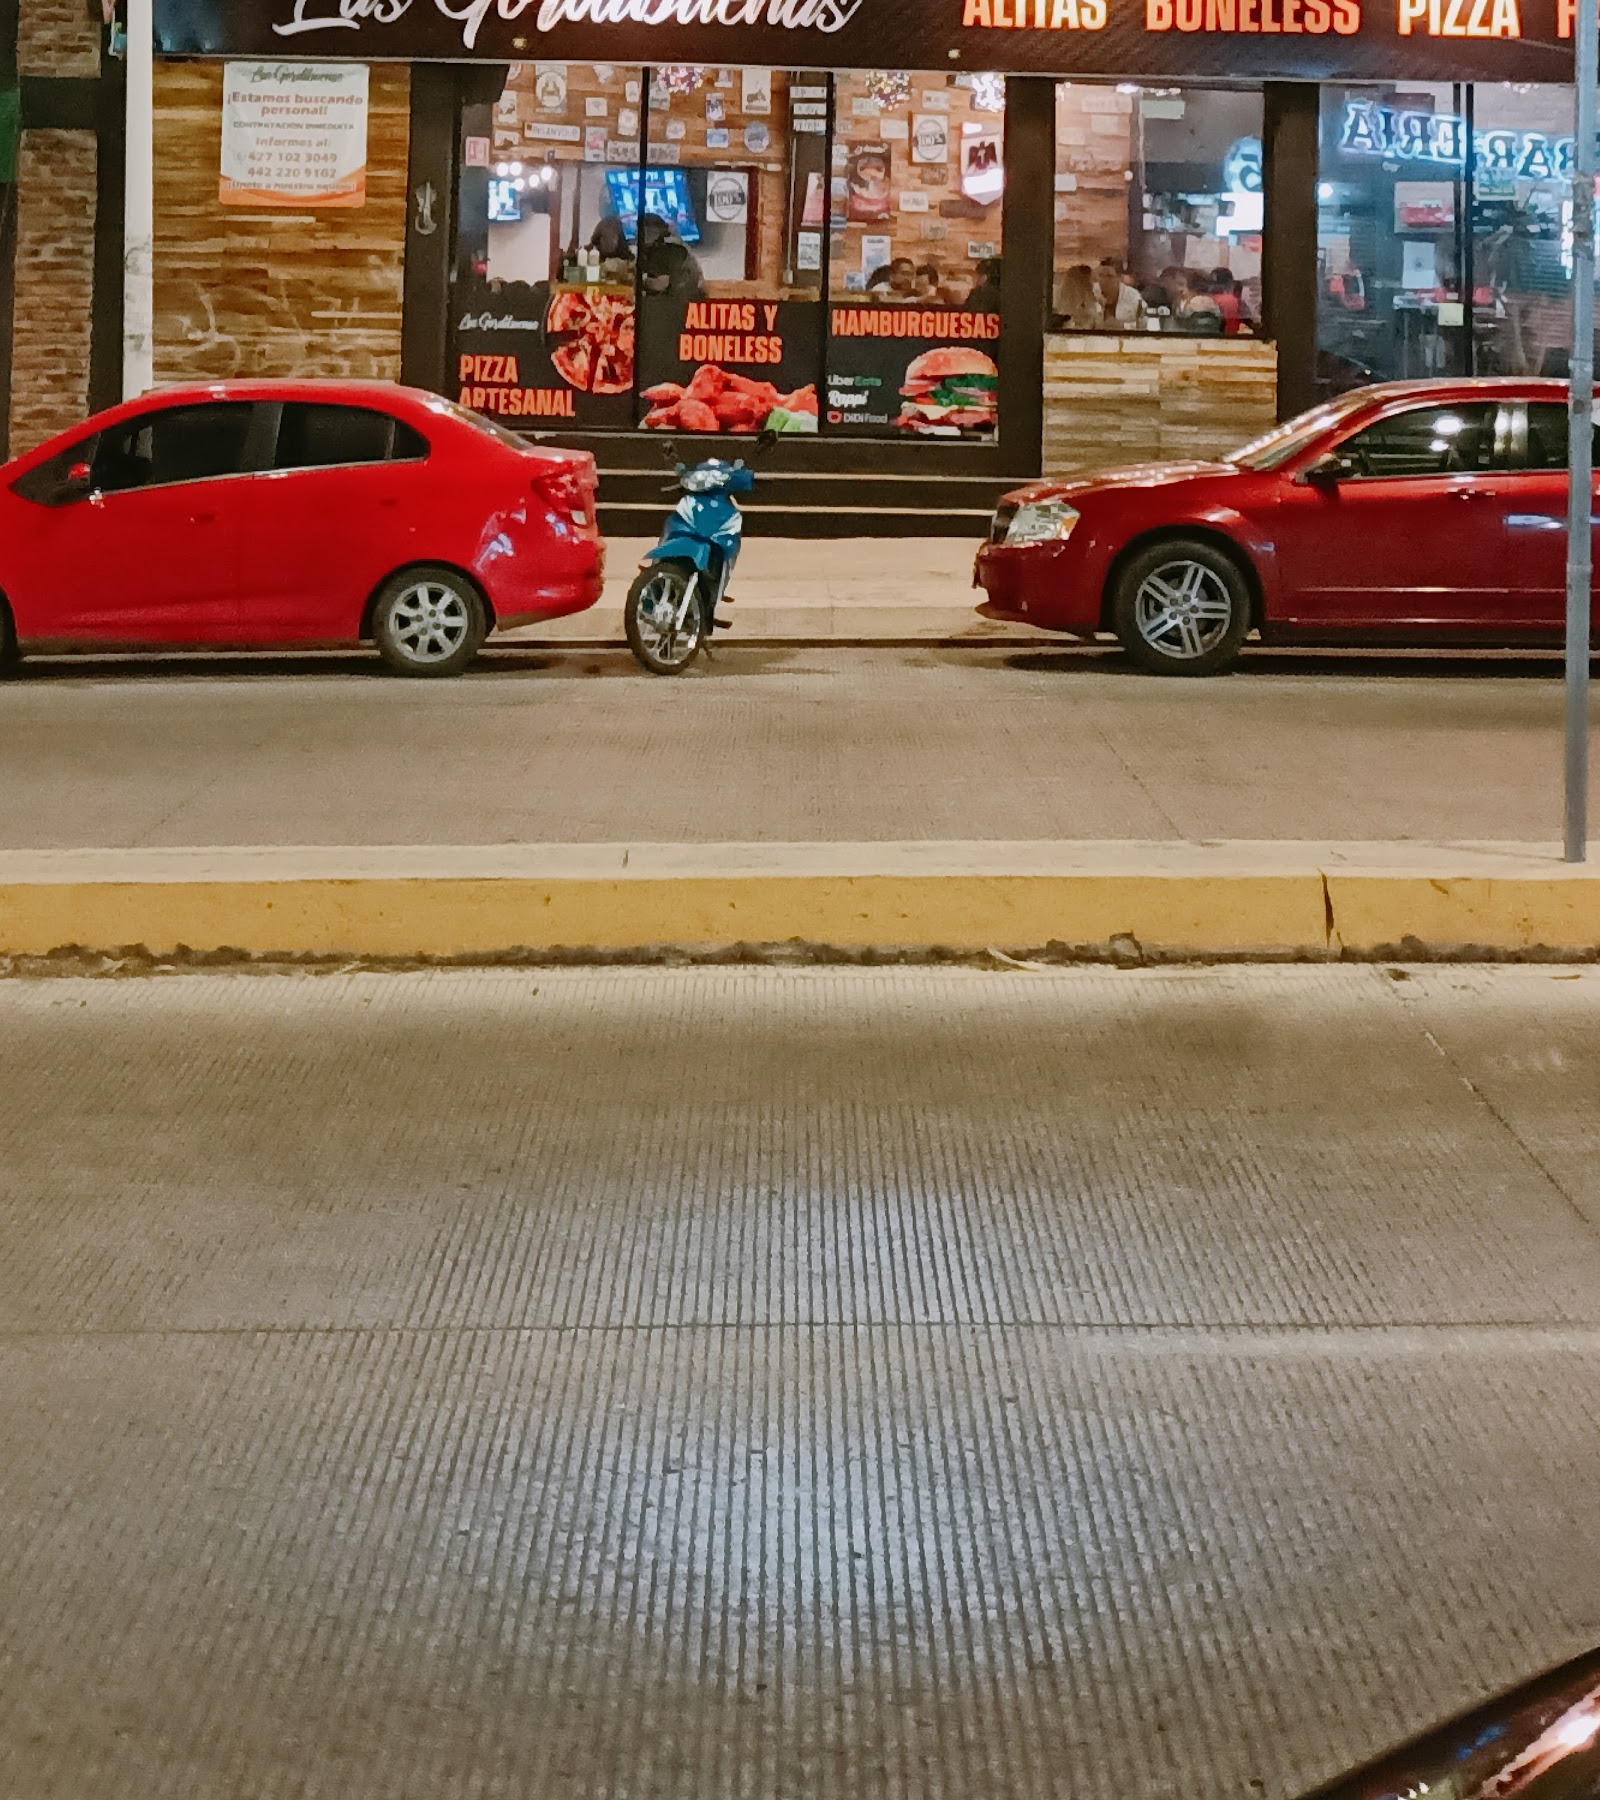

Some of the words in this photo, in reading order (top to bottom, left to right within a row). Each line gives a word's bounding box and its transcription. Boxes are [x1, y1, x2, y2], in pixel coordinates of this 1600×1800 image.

[294, 92, 364, 106] buscando
[684, 302, 755, 331] ALITAS
[763, 303, 778, 332] Y
[831, 308, 1000, 339] HAMBURGUESAS
[679, 334, 783, 364] BONELESS
[459, 353, 518, 383] PIZZA
[827, 374, 854, 386] Uber
[459, 386, 576, 417] ARTESANAL
